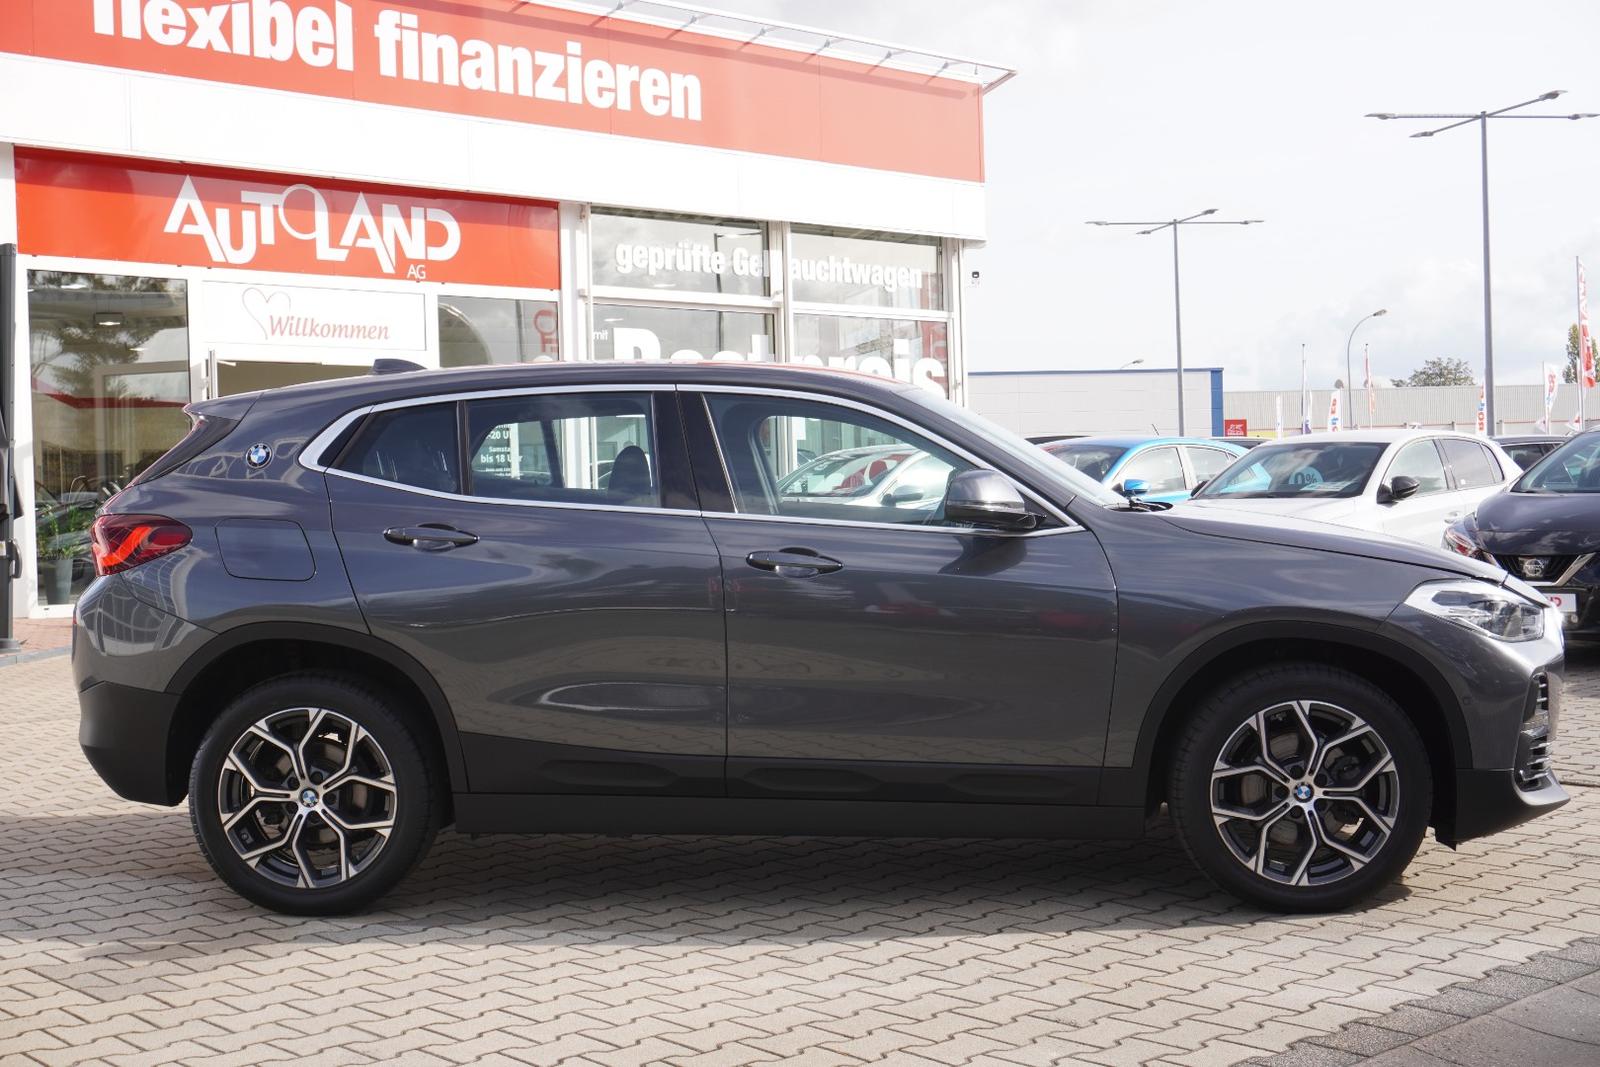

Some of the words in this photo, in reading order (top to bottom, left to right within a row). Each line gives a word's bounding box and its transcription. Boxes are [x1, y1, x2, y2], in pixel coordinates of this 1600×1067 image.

[374, 9, 702, 121] finanzieren
[406, 264, 427, 279] AG
[615, 239, 726, 276] geprüfte
[732, 247, 922, 292] Geauchtwagen
[269, 314, 390, 340] Willkommen
[480, 454, 494, 463] bis
[495, 454, 505, 463] 18
